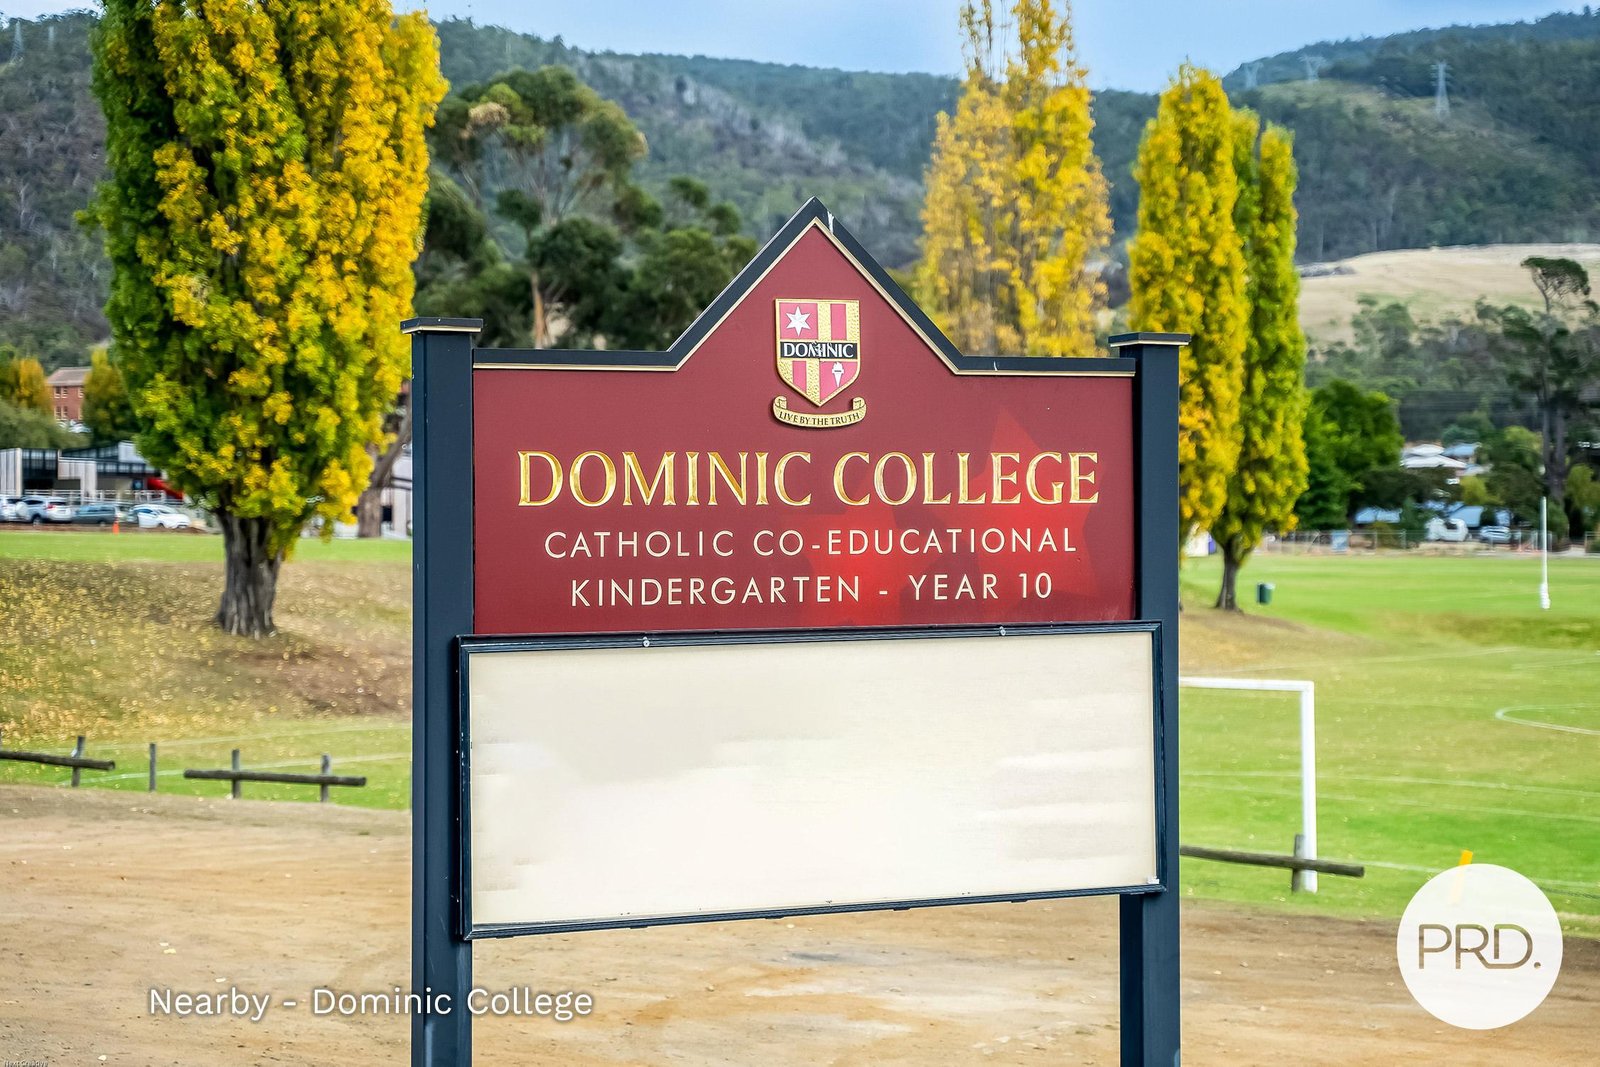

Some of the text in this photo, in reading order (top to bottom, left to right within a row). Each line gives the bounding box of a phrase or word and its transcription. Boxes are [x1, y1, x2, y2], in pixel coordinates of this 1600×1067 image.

[783, 342, 854, 358] DOMINIC
[779, 411, 860, 426] LIVE BY THE TRUTH
[517, 451, 1099, 507] DOMINIC COLLEGE
[545, 527, 1077, 559] CATHOLIC CO-EDUCATIONAL
[571, 575, 860, 607] KINDERGARTEN
[909, 573, 999, 600] YEAR
[1018, 572, 1052, 599] 10
